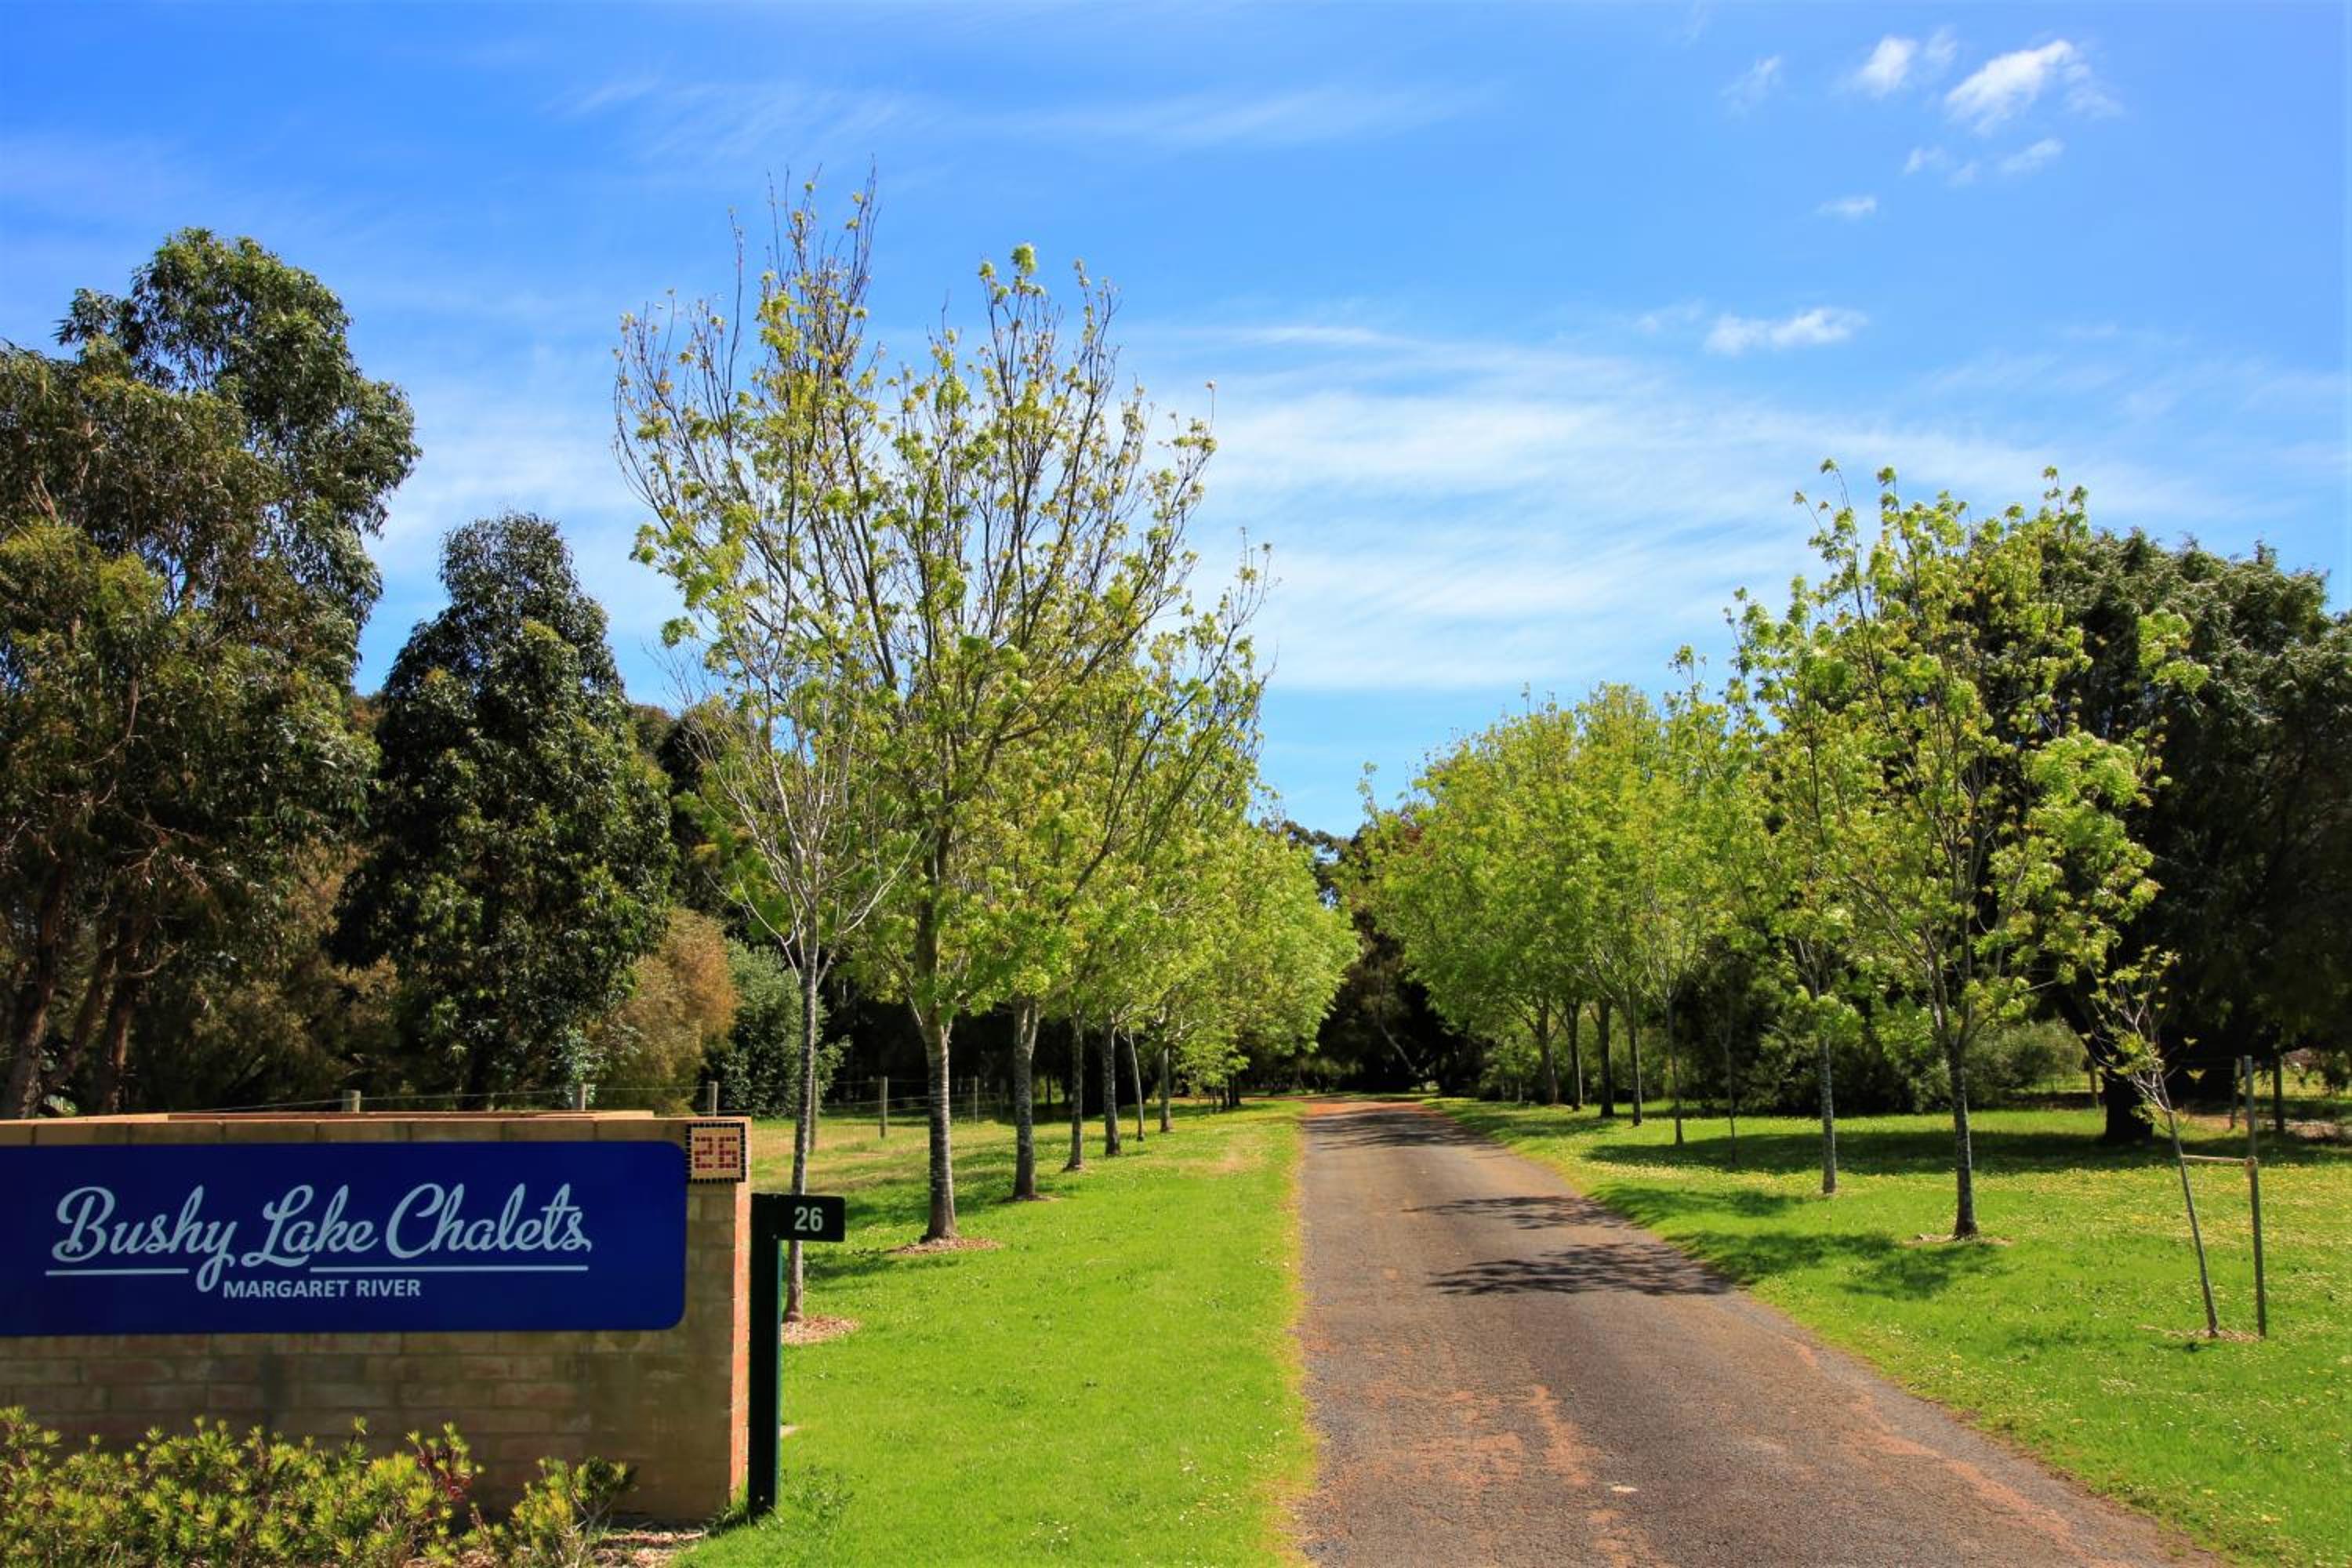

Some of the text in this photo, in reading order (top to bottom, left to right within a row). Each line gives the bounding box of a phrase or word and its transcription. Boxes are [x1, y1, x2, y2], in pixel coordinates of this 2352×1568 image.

[694, 1137, 738, 1169] 26
[794, 1207, 823, 1232] 26
[52, 1183, 592, 1292] Bushy Lake Chalets
[223, 1279, 421, 1298] MARGARET RIVER
